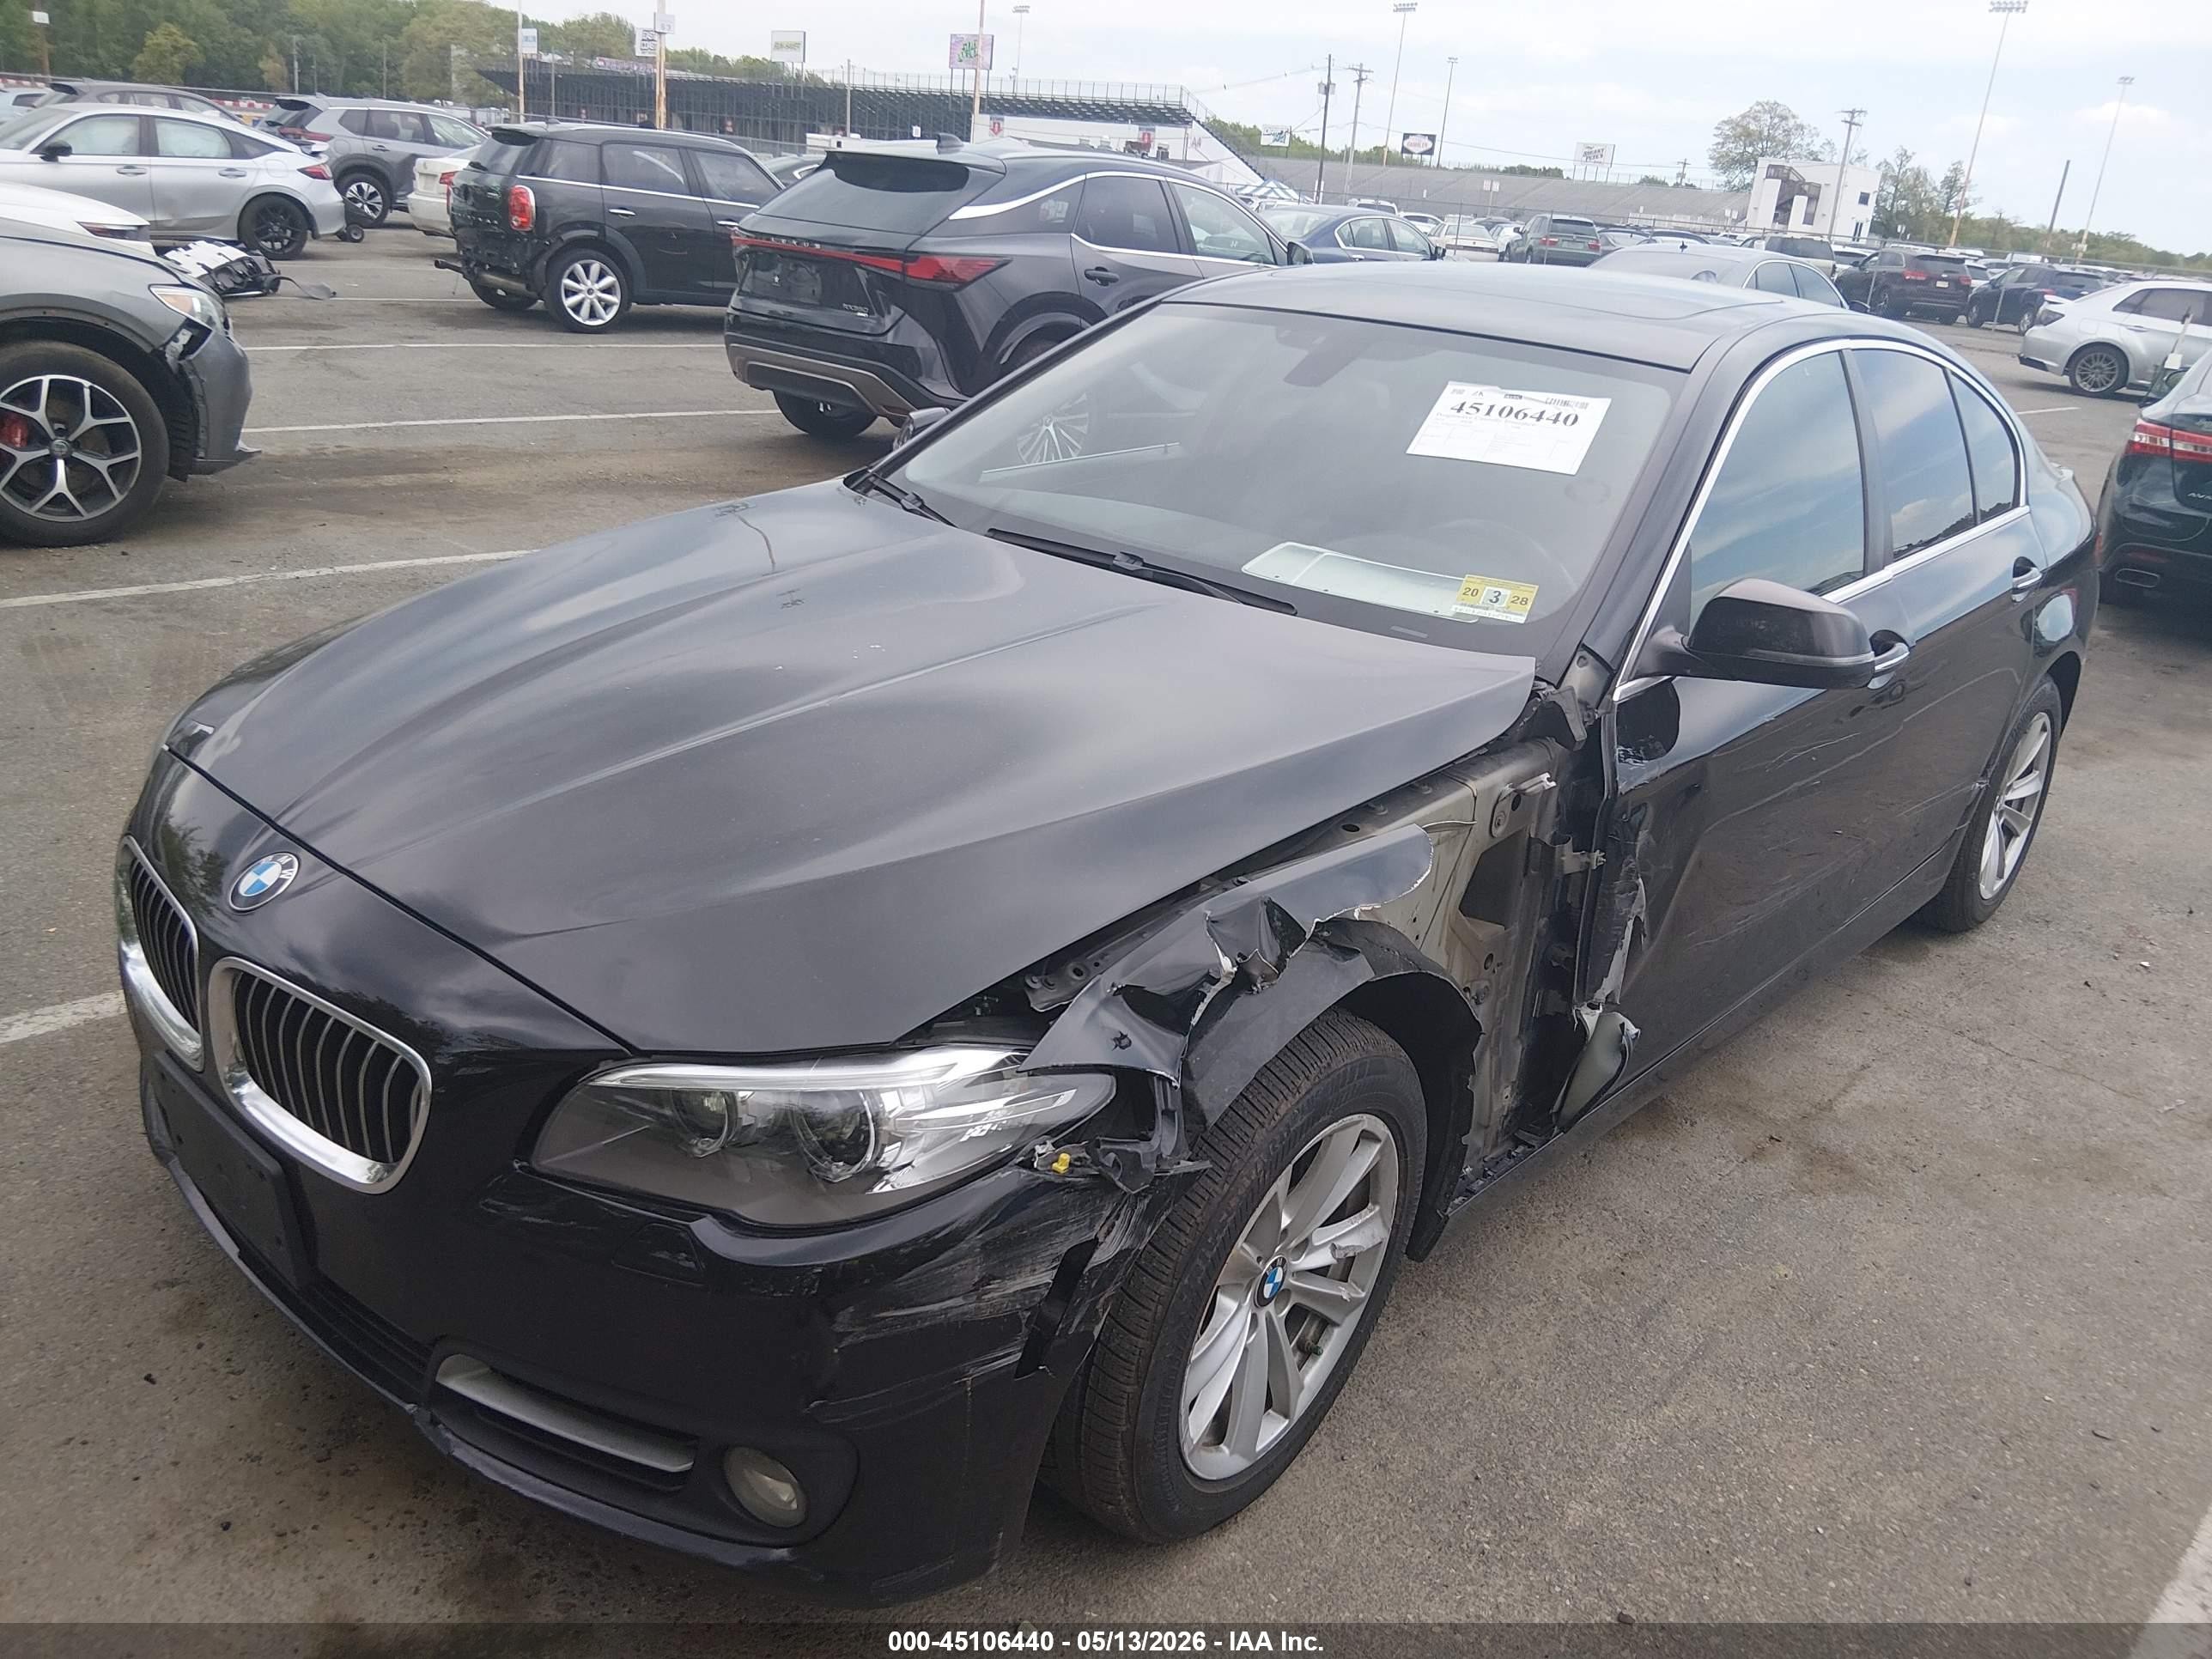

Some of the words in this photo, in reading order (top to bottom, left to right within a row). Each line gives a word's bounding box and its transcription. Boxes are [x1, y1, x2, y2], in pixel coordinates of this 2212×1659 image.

[770, 237, 821, 249] LEXUS
[1450, 401, 1578, 427] 45106440
[1462, 586, 1480, 598] 20
[1488, 590, 1502, 604] 3
[1510, 595, 1528, 606] 28
